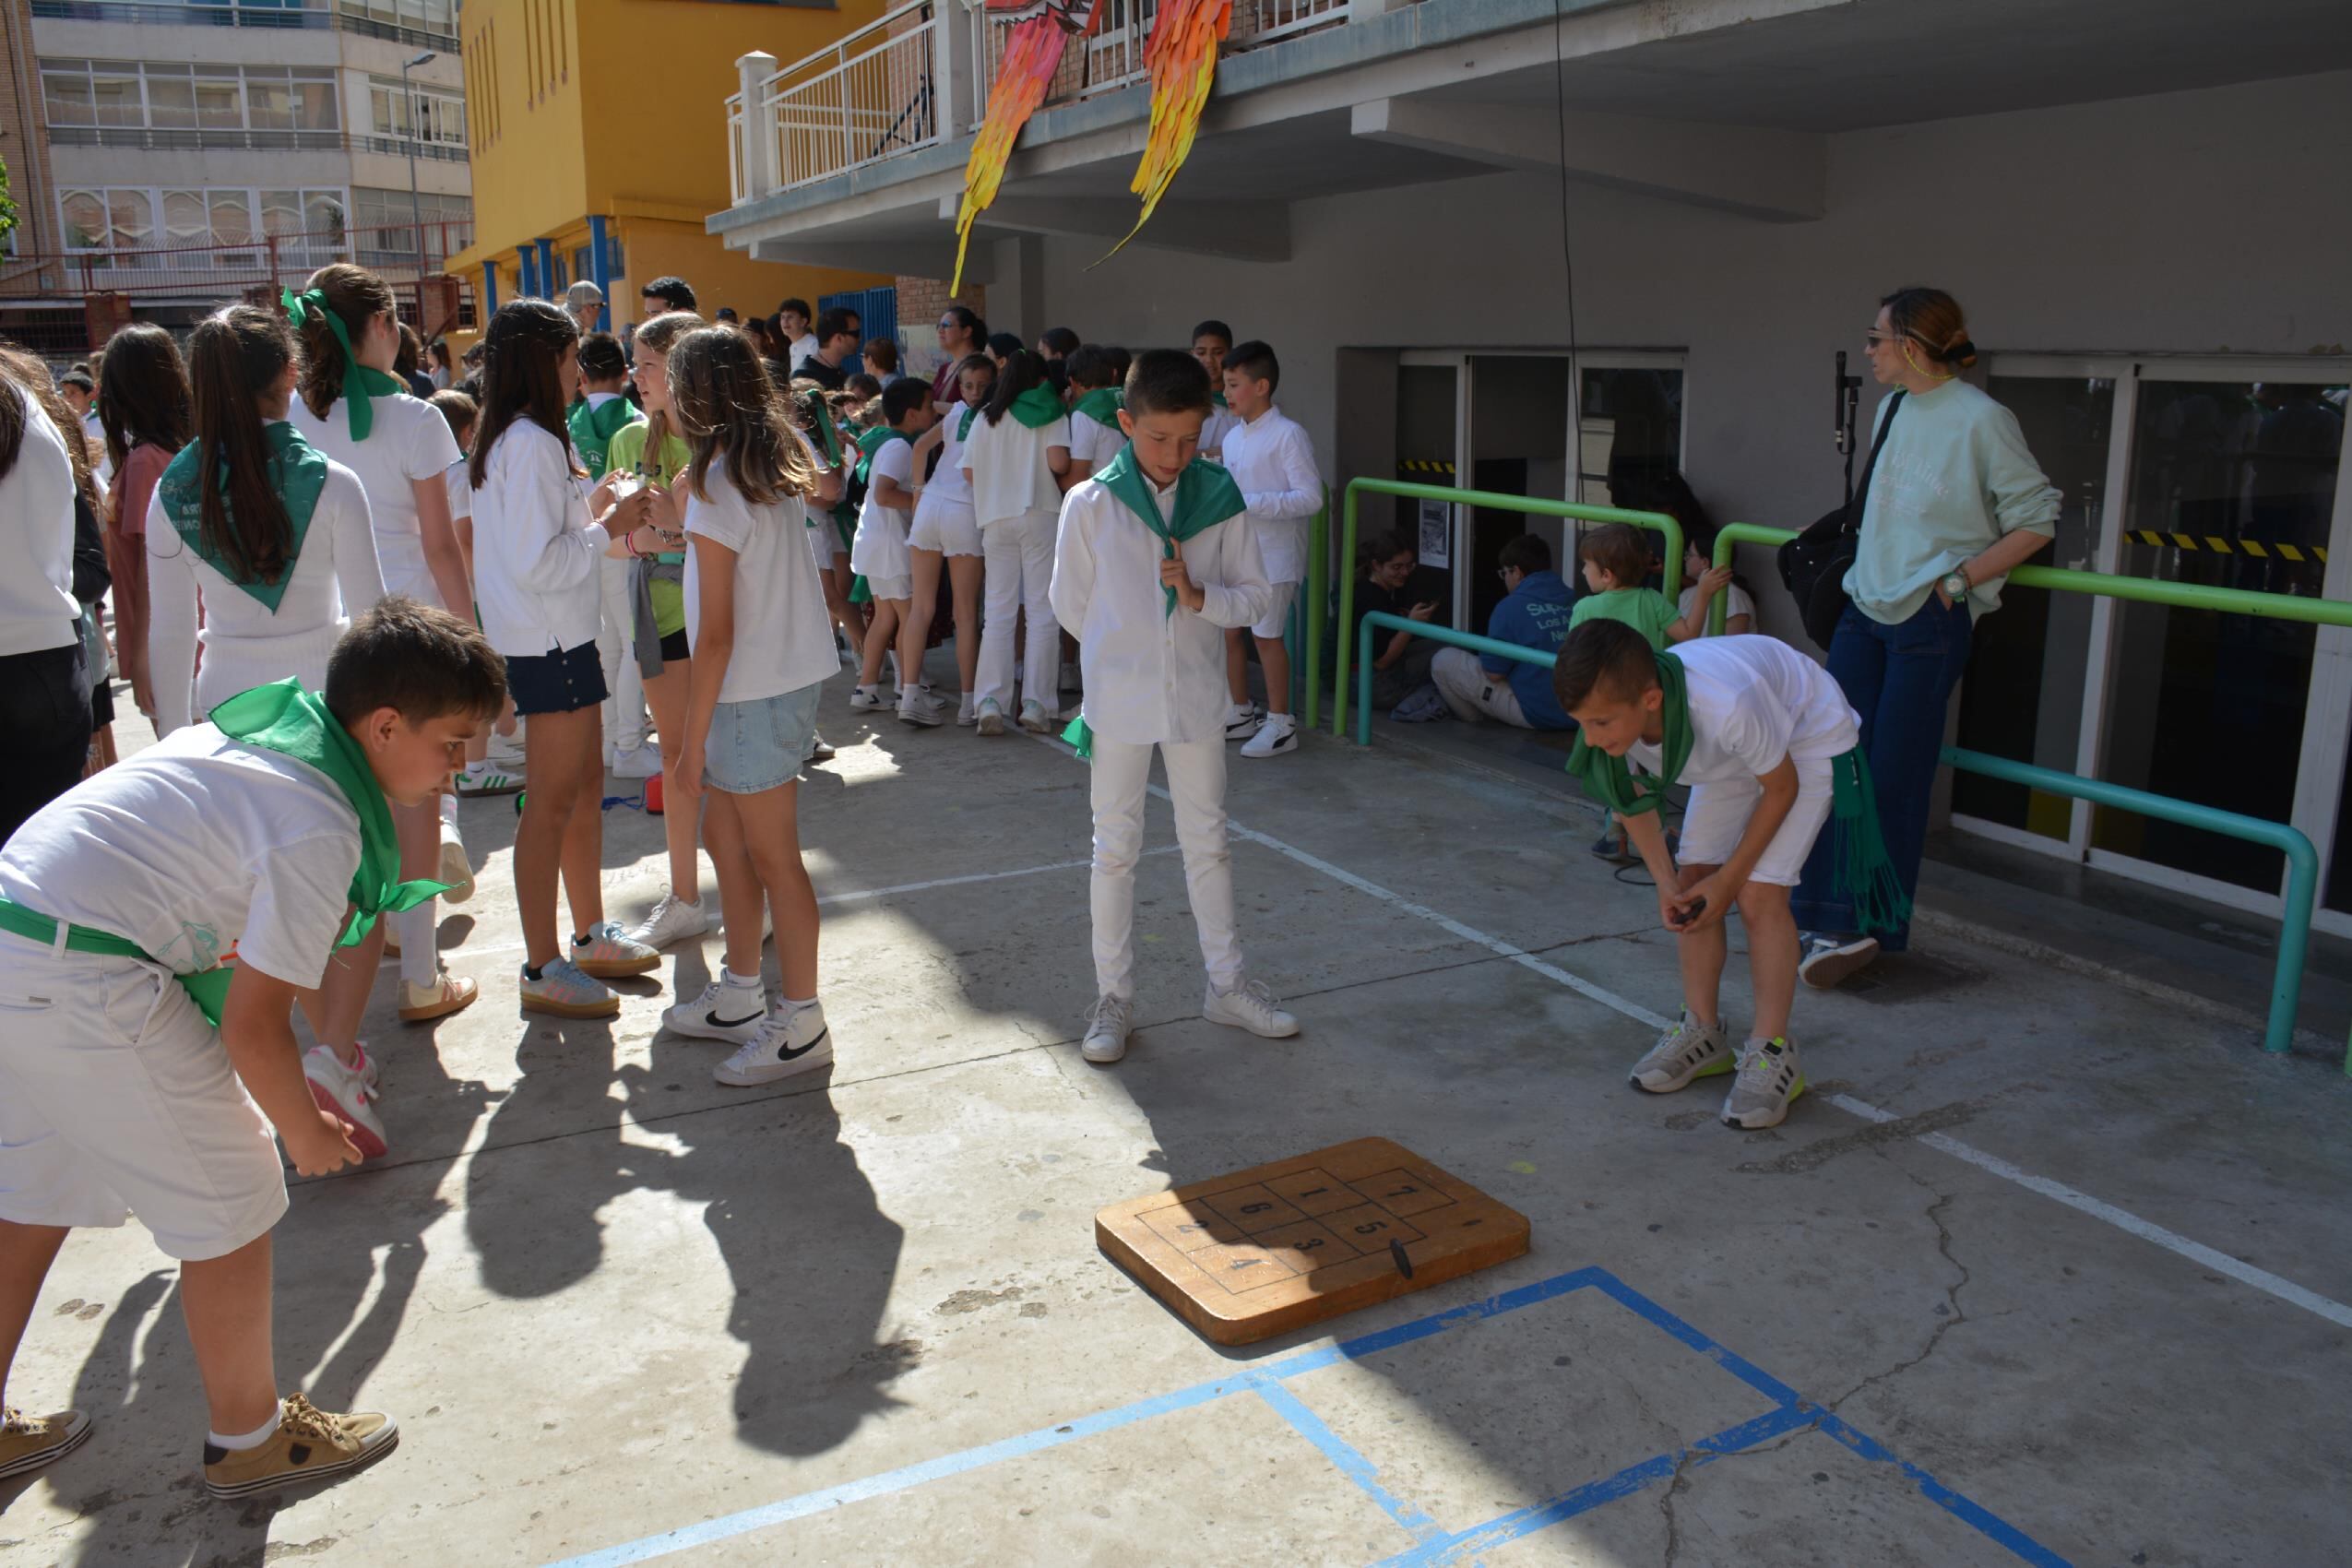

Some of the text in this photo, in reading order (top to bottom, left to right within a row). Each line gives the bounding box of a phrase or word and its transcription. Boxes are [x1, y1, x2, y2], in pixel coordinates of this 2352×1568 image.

[1240, 1202, 1272, 1215] 6
[1176, 1219, 1209, 1234] 2
[1354, 1221, 1388, 1234] 5
[1293, 1238, 1324, 1251] 3
